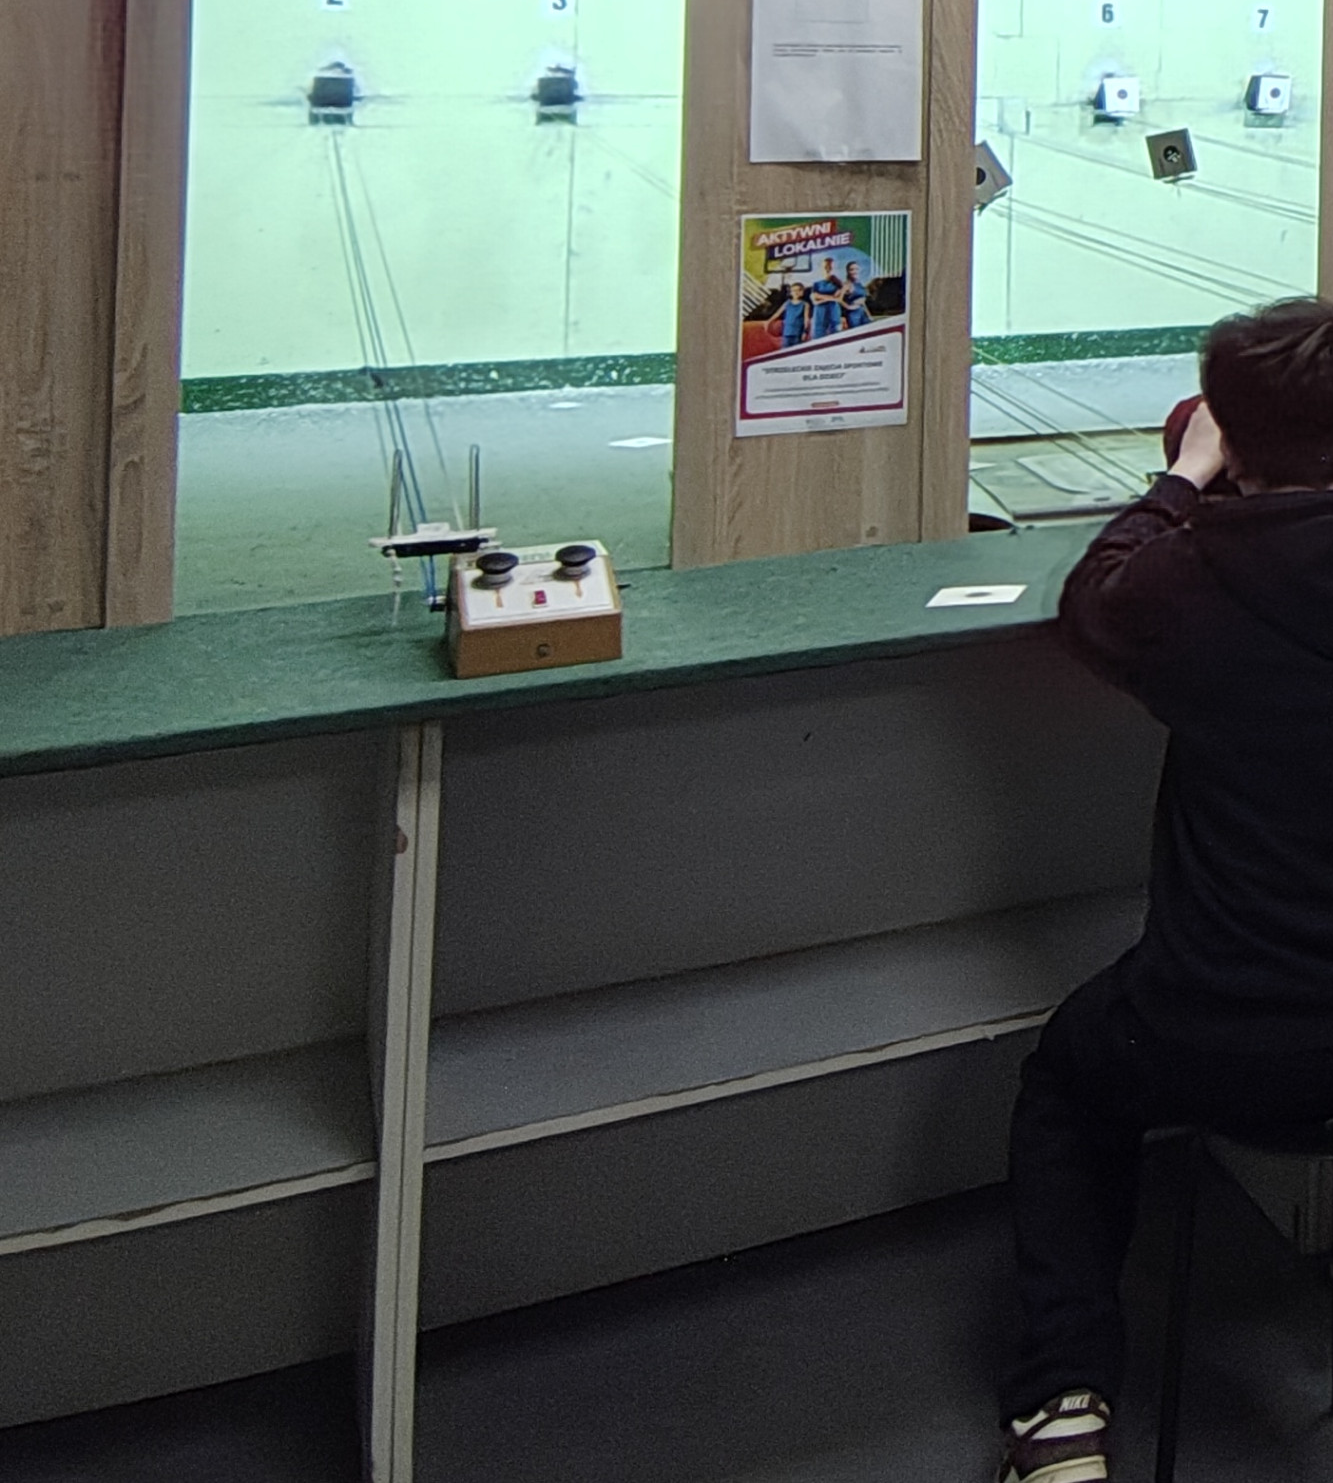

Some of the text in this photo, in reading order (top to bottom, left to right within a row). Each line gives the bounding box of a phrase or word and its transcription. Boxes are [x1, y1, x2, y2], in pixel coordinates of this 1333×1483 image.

[1101, 3, 1114, 24] 6
[1257, 8, 1269, 29] 7
[756, 221, 831, 246] AKTYWNI
[774, 232, 851, 258] LOKALNIE
